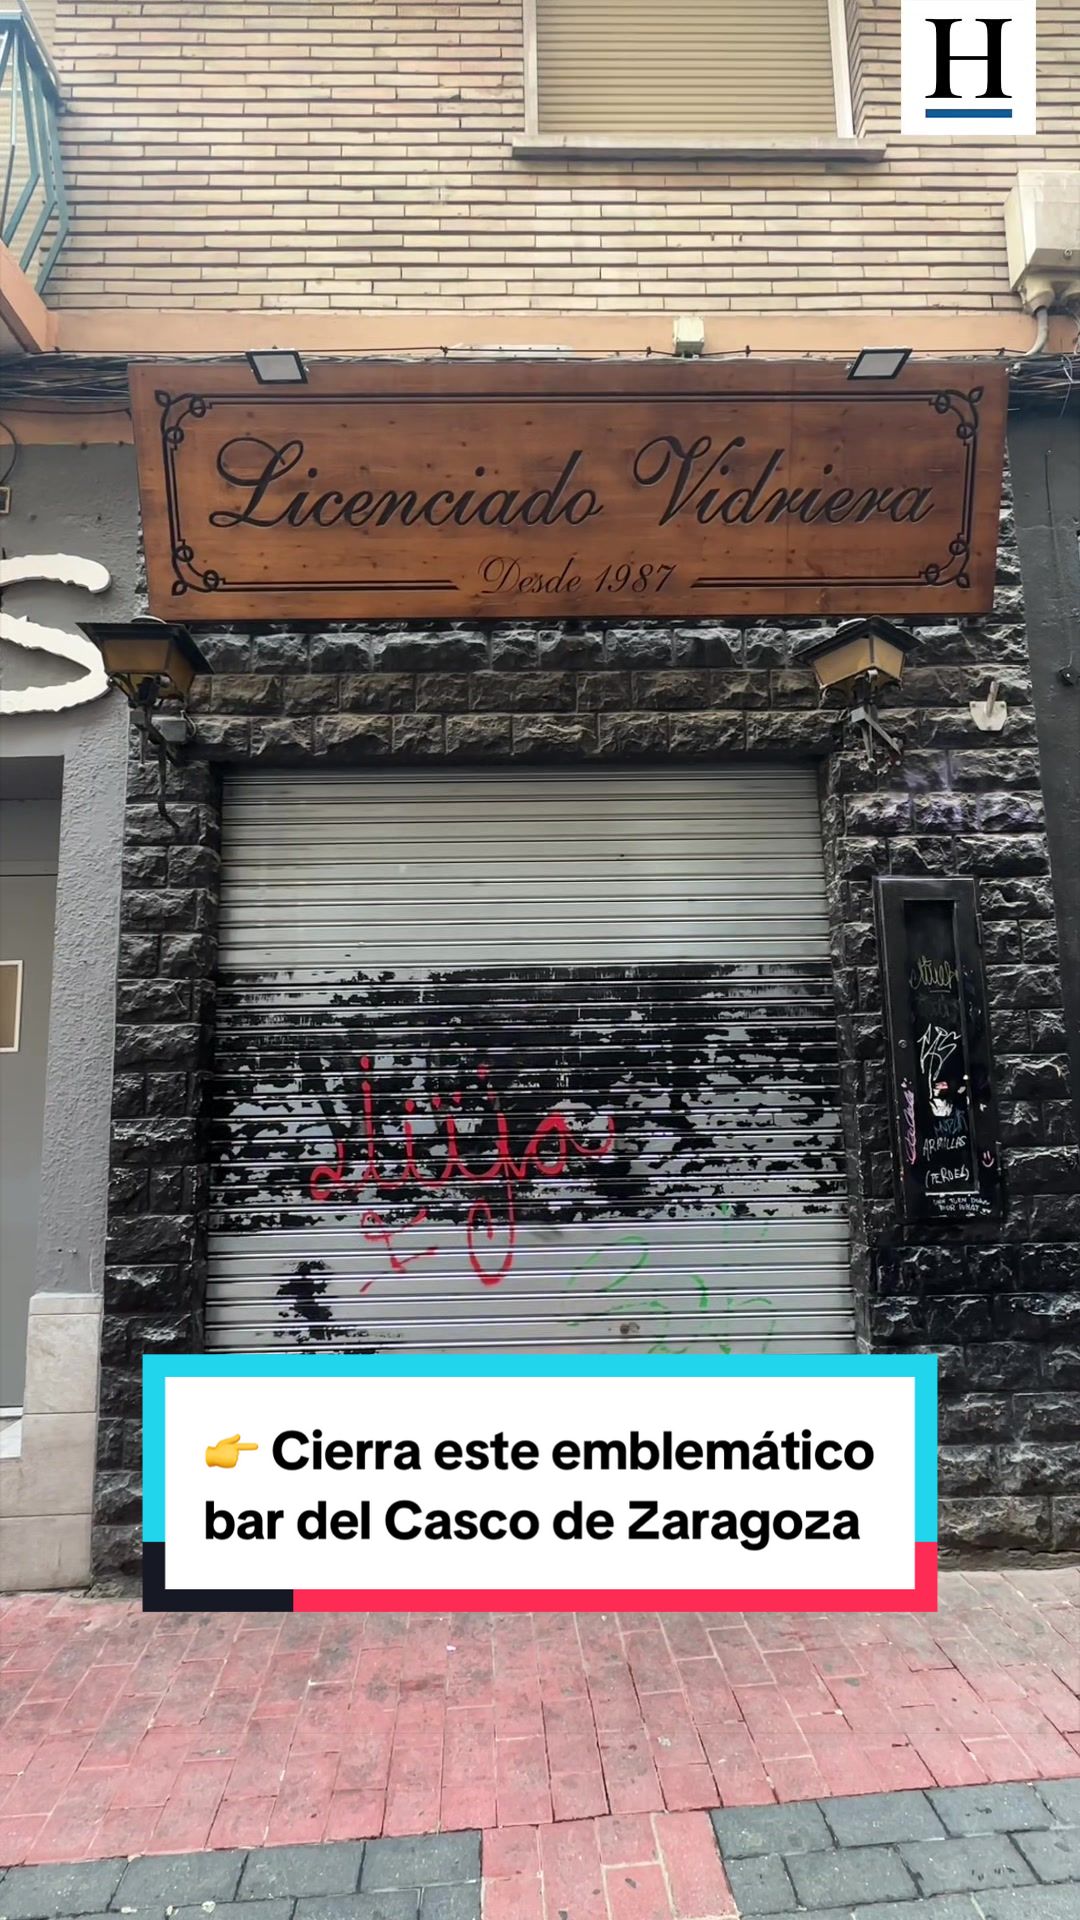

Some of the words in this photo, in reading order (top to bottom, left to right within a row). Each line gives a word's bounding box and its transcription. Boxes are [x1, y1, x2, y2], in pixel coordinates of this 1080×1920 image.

[208, 436, 603, 528] Licenciado
[633, 435, 936, 526] Vidriera
[477, 555, 582, 594] Desde
[595, 562, 678, 594] 1987
